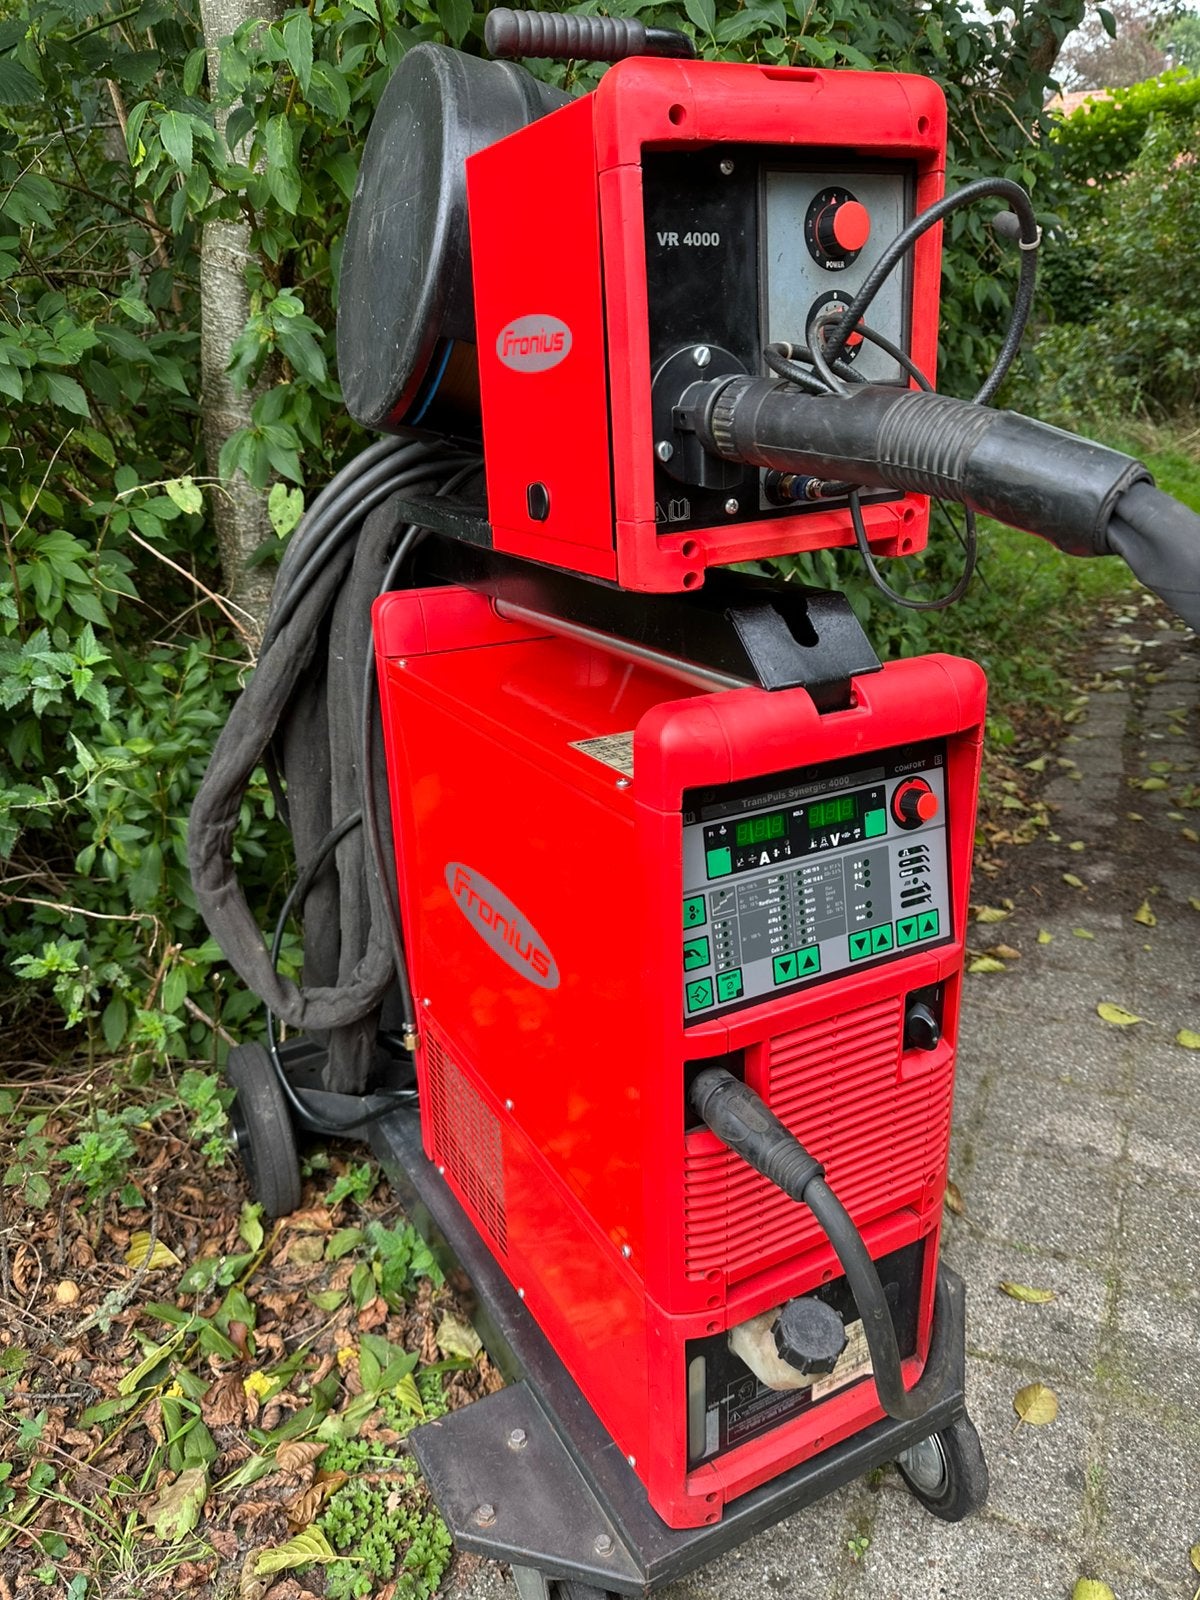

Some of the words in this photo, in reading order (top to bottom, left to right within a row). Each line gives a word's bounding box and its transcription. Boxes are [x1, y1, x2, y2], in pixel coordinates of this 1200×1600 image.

[656, 231, 680, 247] VR
[683, 231, 720, 247] 4000
[826, 260, 845, 268] POWER
[502, 327, 565, 358] Fronius
[895, 760, 926, 773] COMFORT
[742, 793, 786, 808] TransPuls
[788, 782, 827, 799] Synergic
[829, 776, 850, 788] 4000
[830, 832, 841, 847] V
[759, 851, 771, 866] A
[453, 867, 551, 979] Fronius
